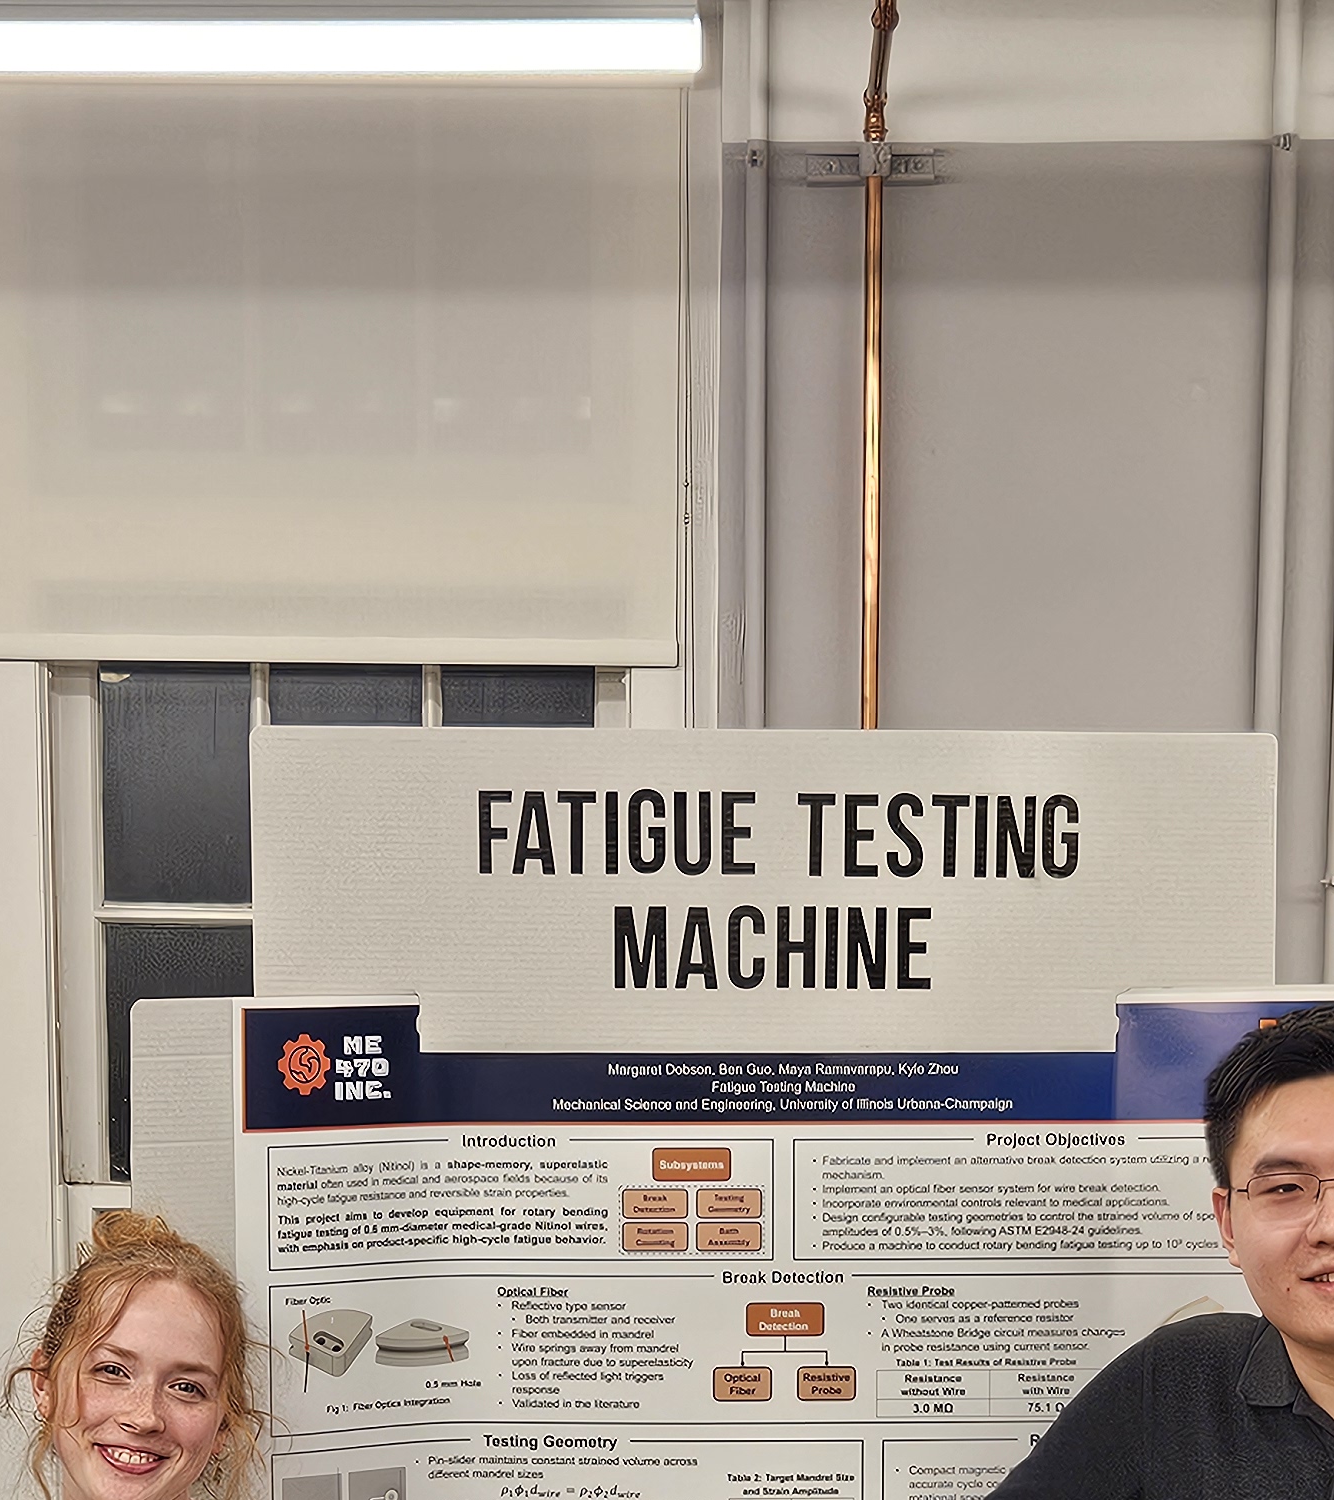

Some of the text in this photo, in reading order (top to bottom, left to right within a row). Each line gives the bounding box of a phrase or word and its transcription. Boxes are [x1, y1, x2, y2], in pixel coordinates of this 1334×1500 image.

[478, 789, 1079, 878] FATIGUE TESTING
[614, 905, 931, 989] MACHINE
[343, 1035, 382, 1055] ME
[335, 1058, 389, 1078] 470
[607, 1064, 662, 1078] Margaret
[665, 1063, 715, 1075] Dobson,
[718, 1063, 742, 1075] Ben
[746, 1063, 775, 1075] Guo,
[778, 1064, 811, 1077] Maya
[898, 1063, 924, 1077] Kyle
[927, 1063, 958, 1074] Zhou
[334, 1080, 392, 1100] INC.
[711, 1081, 855, 1095] Fatigue Testing Machine
[552, 1097, 1012, 1112] Mechanical Science and Engineering, University of Illinois Urbana-Champaign
[462, 1135, 555, 1147] Introduction
[986, 1132, 1125, 1148] Project Objectives
[659, 1160, 724, 1171] Subsystems
[822, 1185, 876, 1195] Implement
[895, 1184, 930, 1195] optical
[933, 1184, 955, 1193] fiber
[997, 1185, 1034, 1195] system
[1037, 1184, 1051, 1193] for
[1054, 1184, 1075, 1193] wire
[1078, 1184, 1107, 1192] break
[1110, 1184, 1159, 1192] detection.
[822, 1197, 1169, 1209] Incorporate environmental controls relevant to medical applications.
[277, 1206, 609, 1226] This project aims to develop equipment for rotary bending
[722, 1270, 843, 1283] Break Detection
[497, 1287, 569, 1297] Optical Fiber
[868, 1286, 955, 1297] Resistive Probe
[511, 1300, 562, 1310] Reflective
[565, 1302, 587, 1312] type
[770, 1308, 800, 1317] Break
[525, 1314, 675, 1324] Both transmitter and receiver
[758, 1321, 808, 1329] Detection
[511, 1328, 654, 1338] Fiber embedded in mandrel
[511, 1343, 678, 1354] Wire springs away from mandrel
[511, 1357, 693, 1369] upon fracture due to superelasticity
[511, 1371, 663, 1383] Loss of reflected light triggers
[723, 1374, 760, 1384] Optical
[803, 1373, 851, 1382] Resistive
[904, 1374, 961, 1382] Resistance
[1017, 1374, 1074, 1382] Resistance
[511, 1387, 560, 1395] response
[729, 1386, 756, 1394] Fiber
[811, 1386, 842, 1395] Probe
[941, 1387, 965, 1395] Wire
[1022, 1387, 1071, 1397] with Wire
[913, 1402, 953, 1413] 3.0 MΩ
[1027, 1403, 1050, 1412] 75.1
[482, 1435, 617, 1451] Testing Geometry
